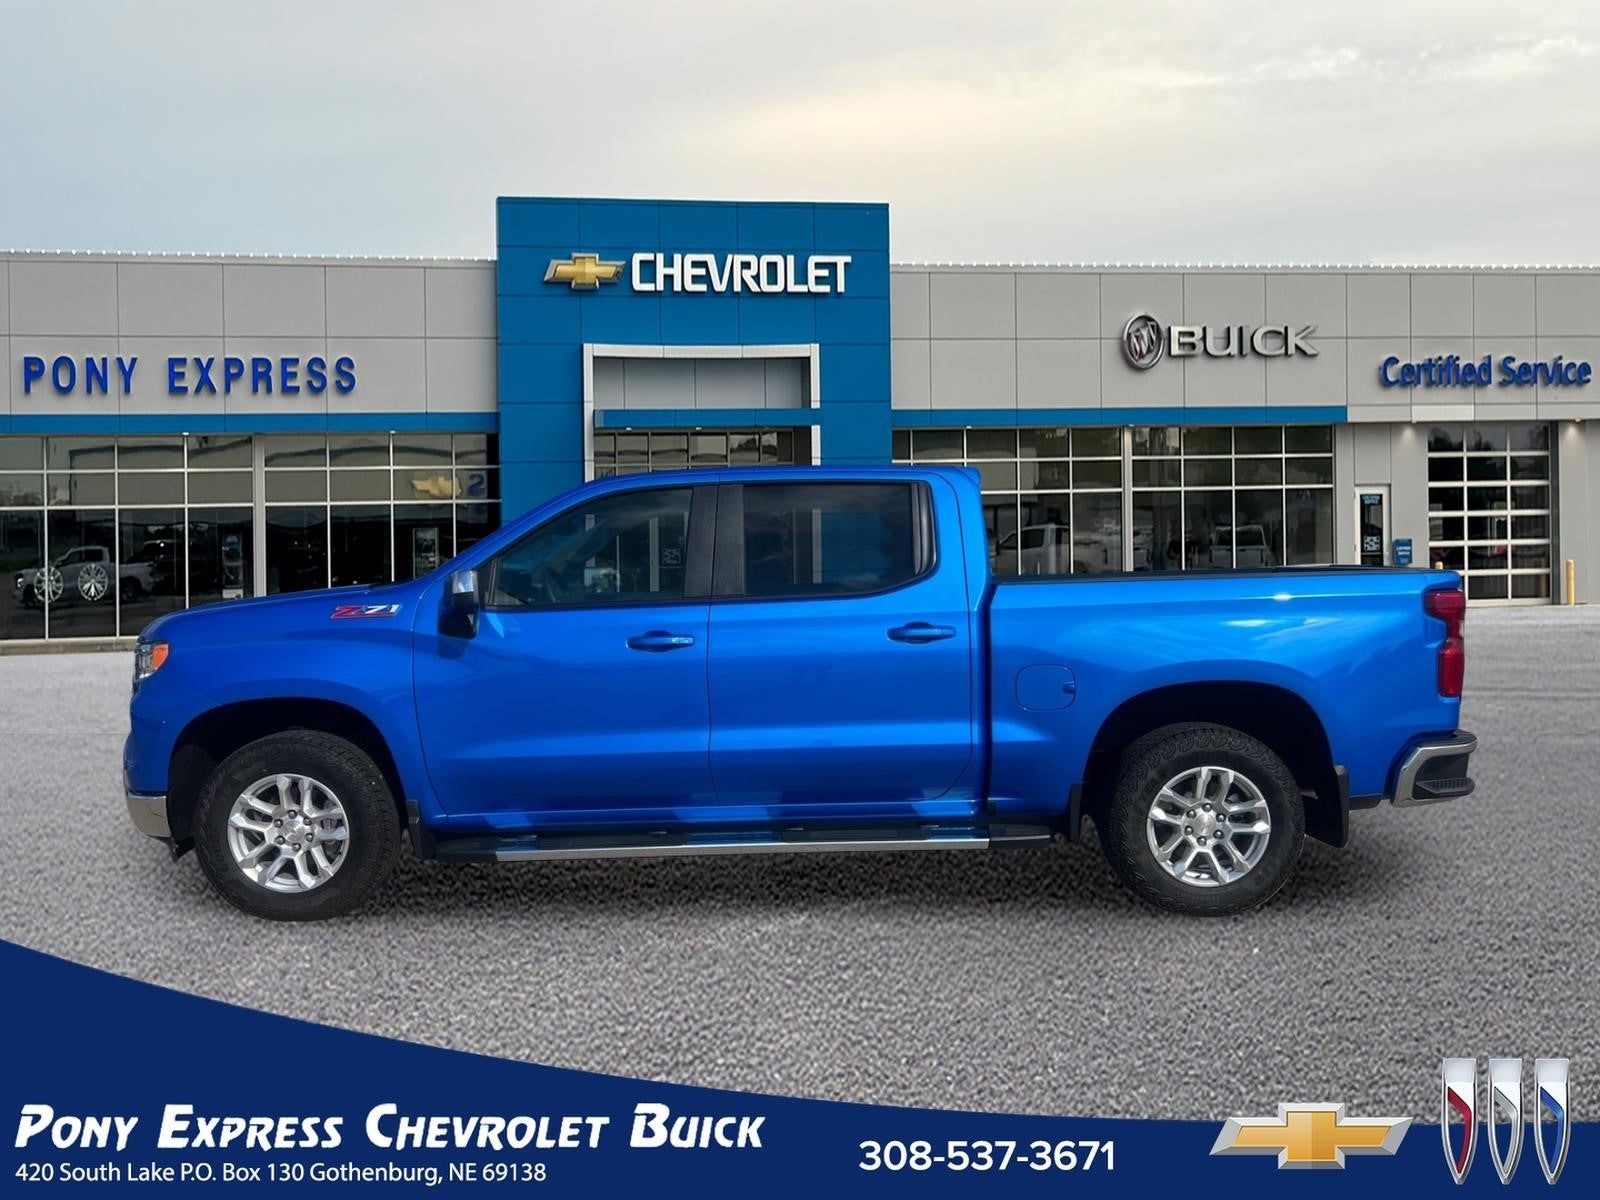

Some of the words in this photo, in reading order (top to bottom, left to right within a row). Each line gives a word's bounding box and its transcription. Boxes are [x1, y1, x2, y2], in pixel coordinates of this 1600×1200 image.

[631, 252, 852, 295] CHEVROLET
[1168, 325, 1319, 358] BUICK
[23, 356, 137, 396] PONY
[167, 357, 357, 395] EXPRESS
[1381, 355, 1492, 386] Certified
[1499, 355, 1592, 386] Service
[330, 603, 400, 618] Z71
